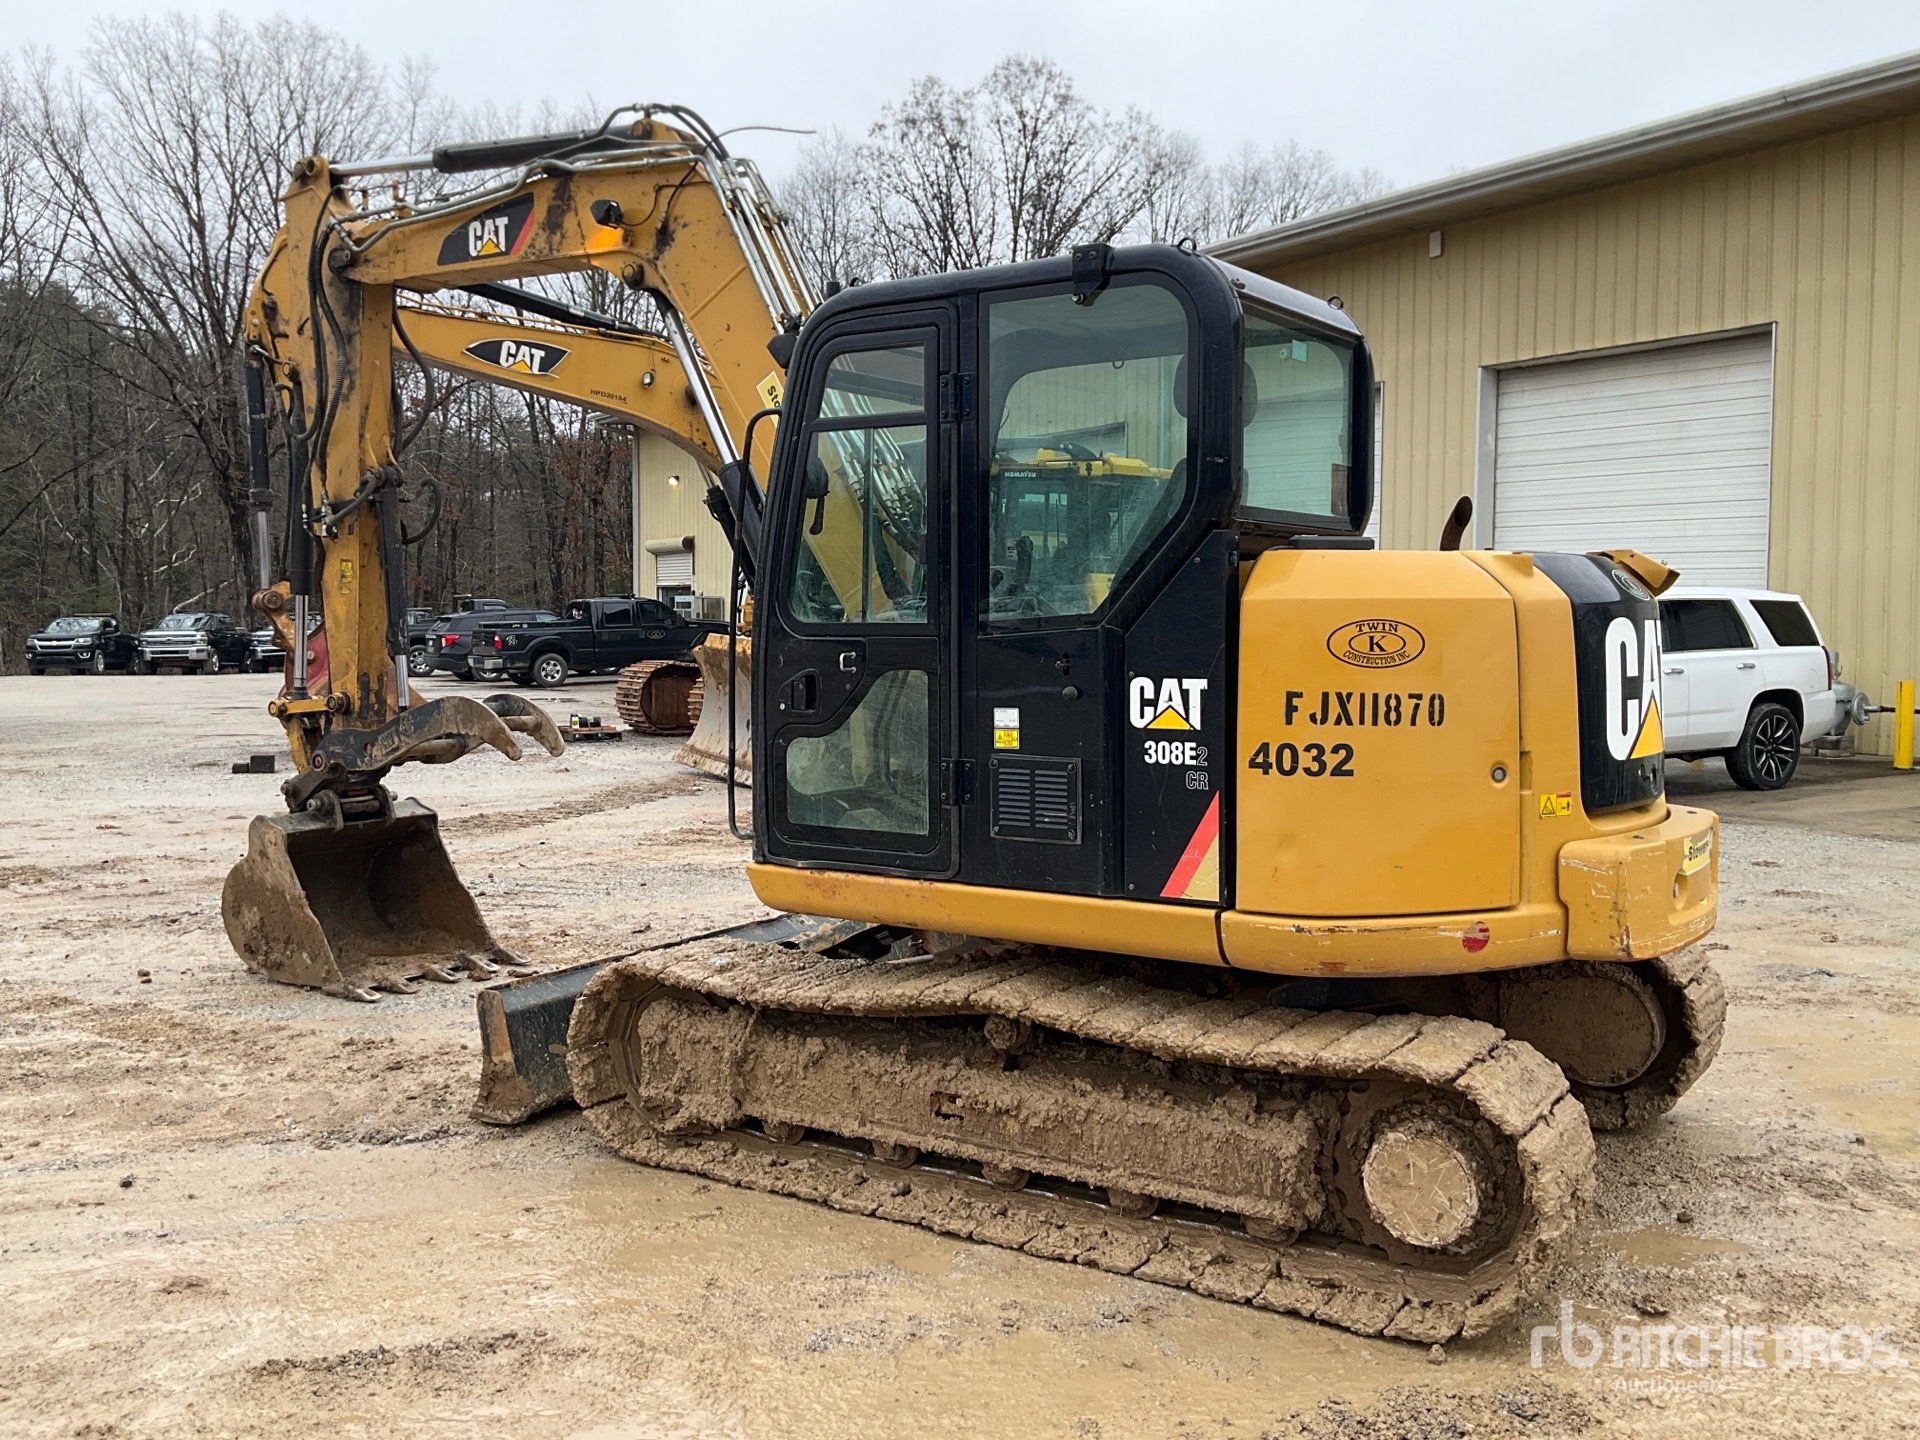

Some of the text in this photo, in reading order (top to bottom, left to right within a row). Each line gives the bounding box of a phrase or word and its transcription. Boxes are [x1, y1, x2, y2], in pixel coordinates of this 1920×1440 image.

[468, 216, 509, 257] CAT
[500, 340, 546, 373] CAT
[1355, 622, 1399, 633] TWIN
[1342, 649, 1411, 666] CONSTRUCTION INC
[1367, 635, 1388, 653] K
[1129, 676, 1208, 731] CAT
[1144, 740, 1208, 767] 308E2
[1248, 741, 1355, 777] 4032
[1185, 770, 1209, 790] CR
